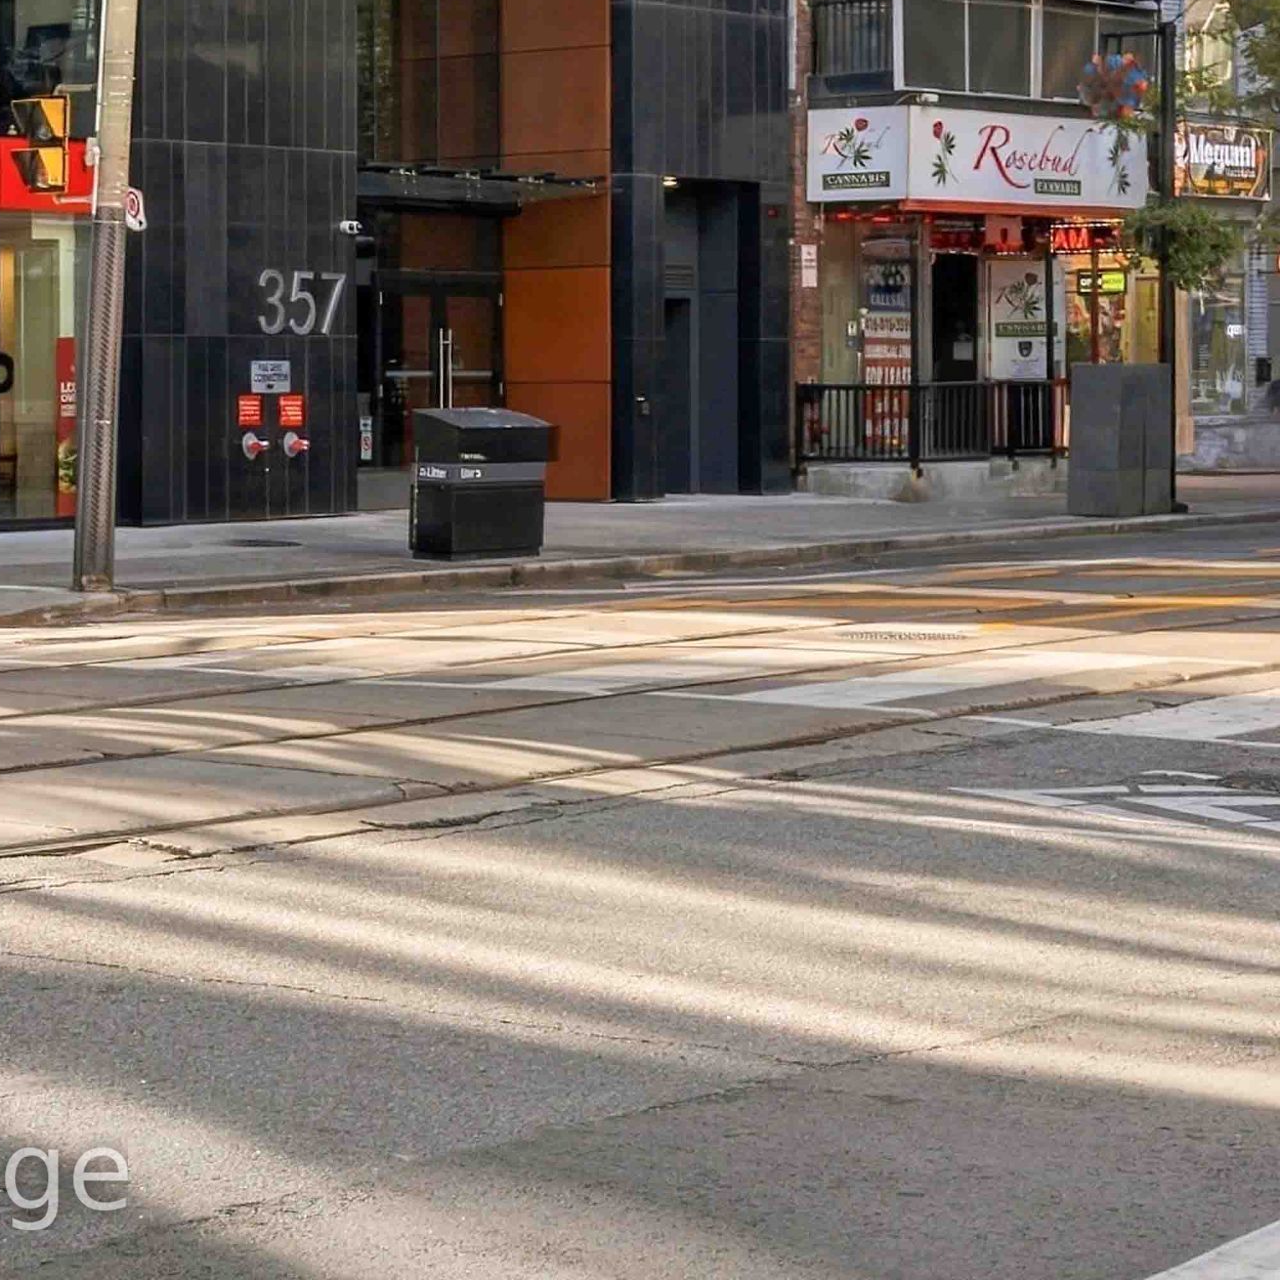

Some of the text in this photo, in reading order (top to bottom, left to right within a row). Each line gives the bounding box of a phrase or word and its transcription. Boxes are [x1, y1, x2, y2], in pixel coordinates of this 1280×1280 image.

[973, 125, 1093, 189] Rosebud
[827, 173, 886, 185] CANNABIS
[1036, 180, 1079, 194] CANNABIS
[258, 268, 346, 335] 357
